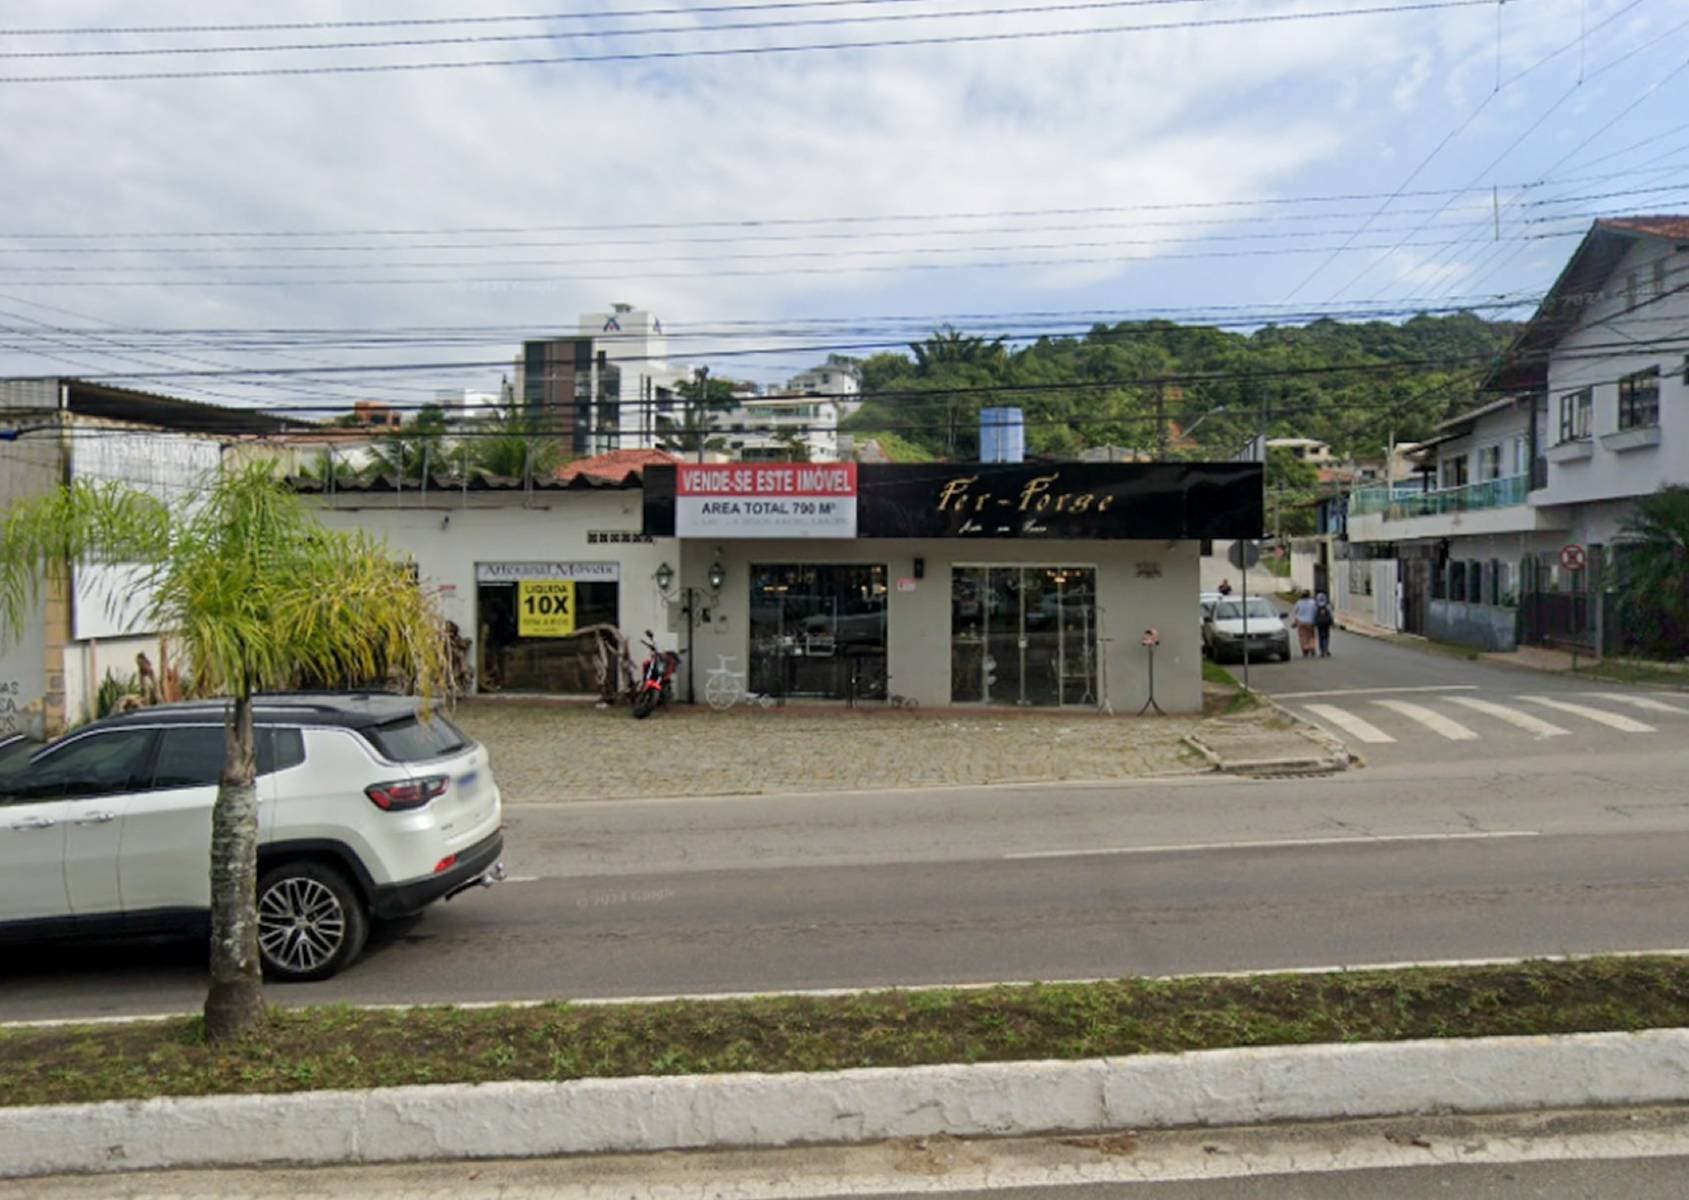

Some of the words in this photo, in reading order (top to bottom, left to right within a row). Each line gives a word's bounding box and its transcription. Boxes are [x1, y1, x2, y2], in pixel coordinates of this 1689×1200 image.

[682, 469, 753, 492] VENDE-SE
[756, 469, 795, 492] ESTE
[797, 466, 852, 492] IMÓVEL
[743, 502, 789, 515] TOTAL
[523, 595, 569, 615] 10X
